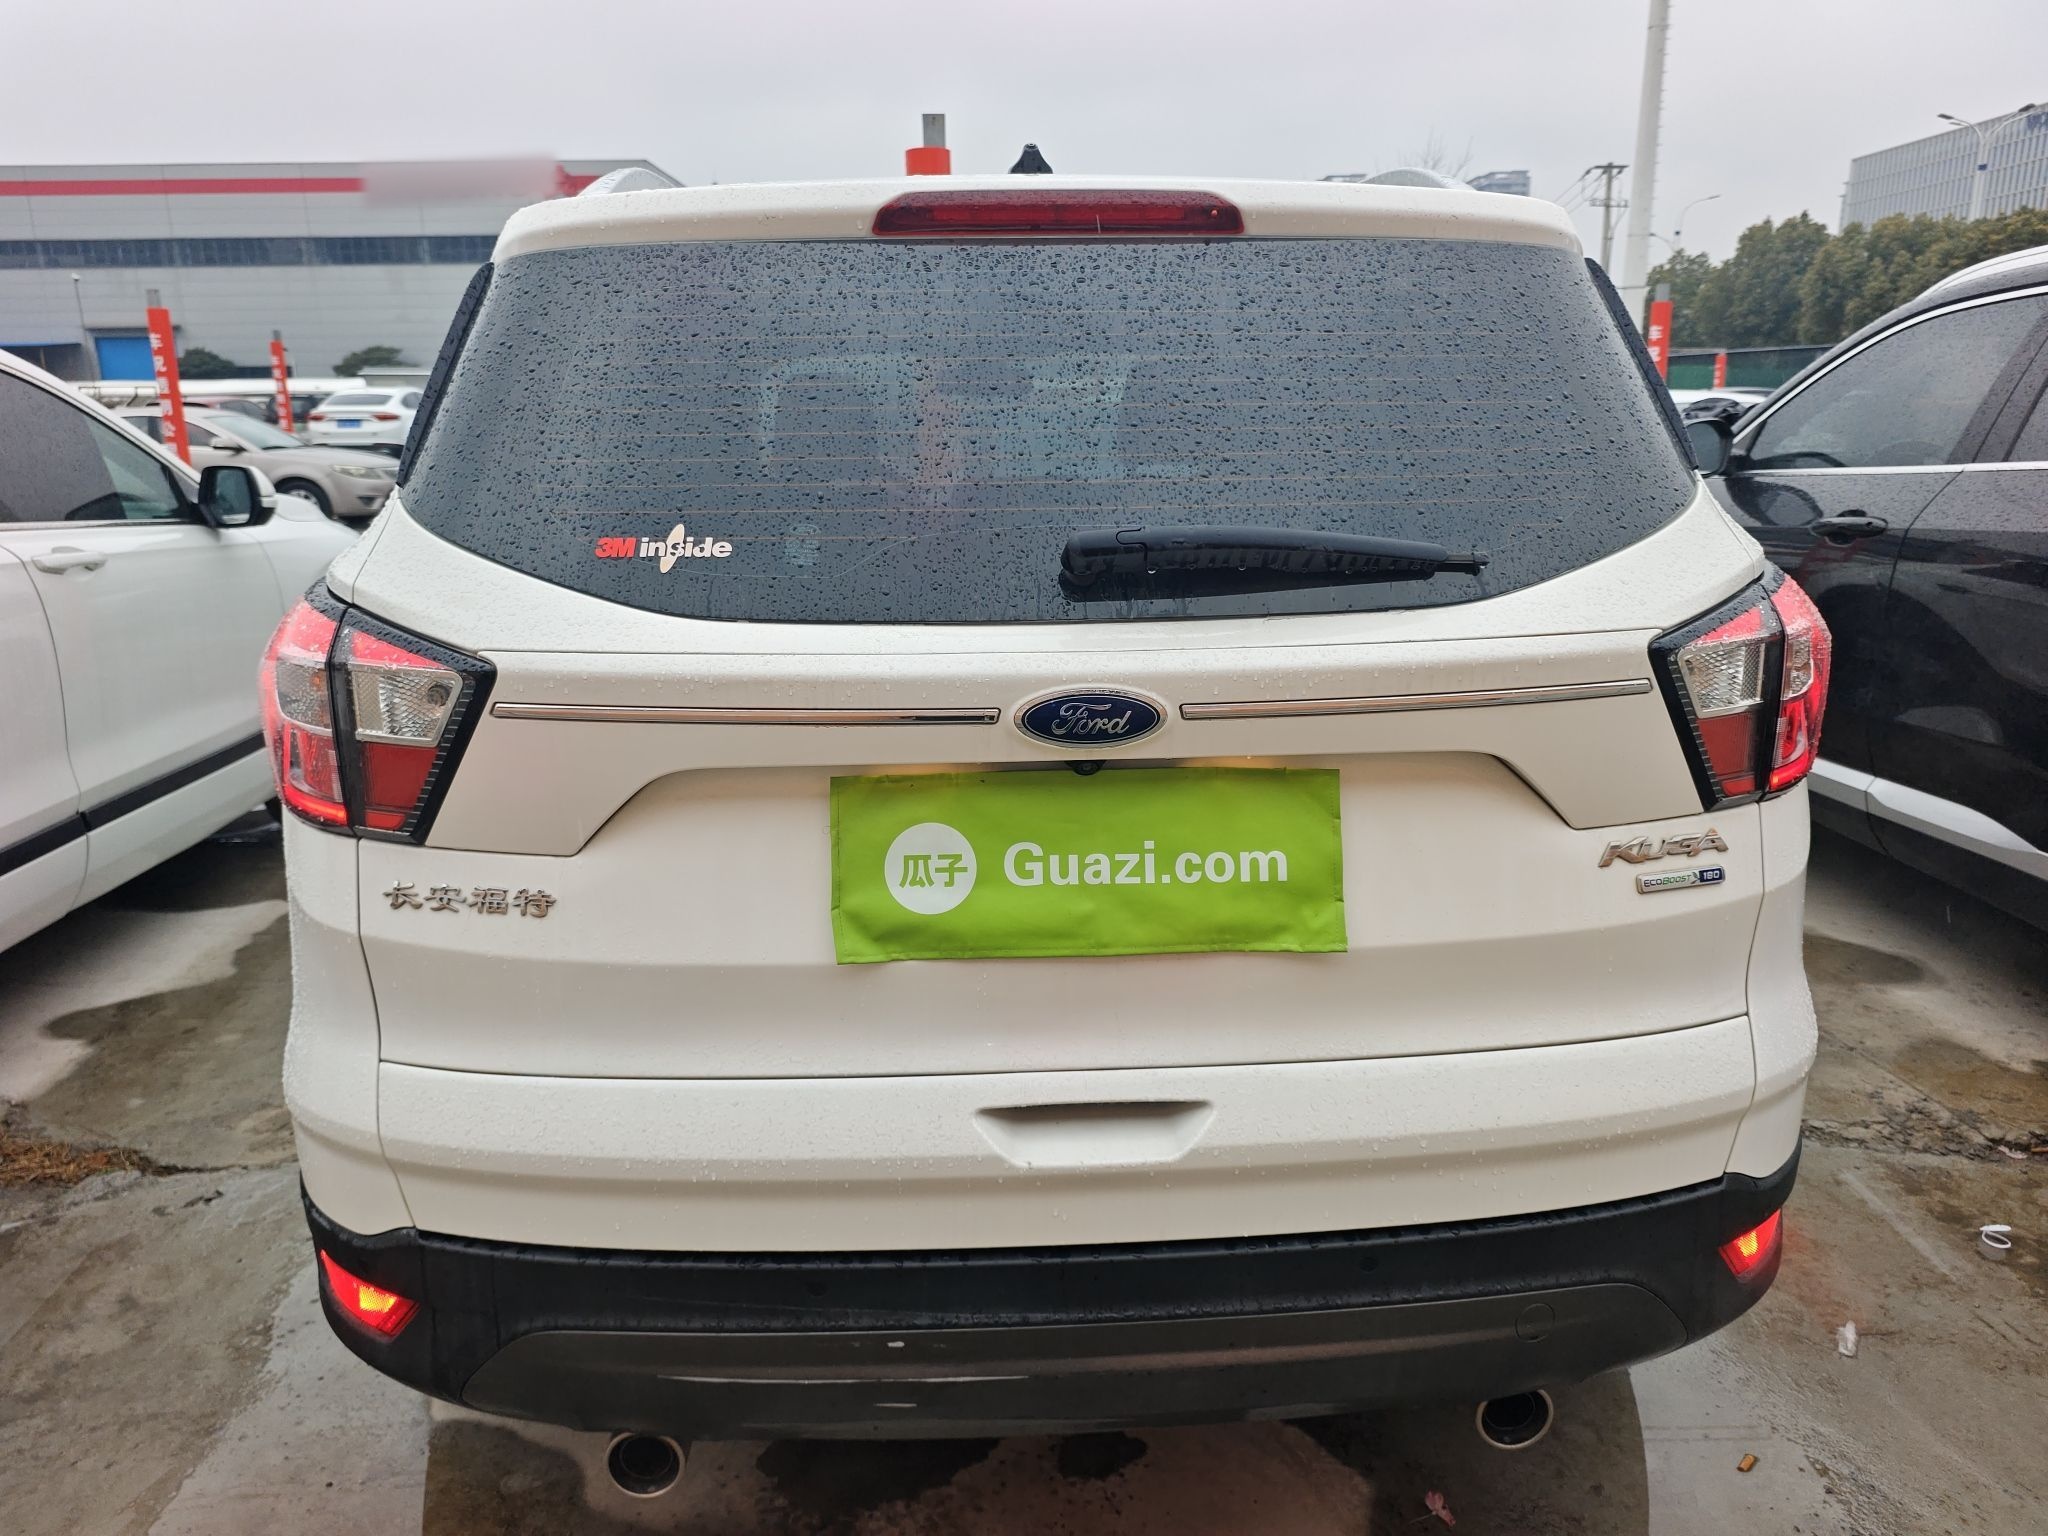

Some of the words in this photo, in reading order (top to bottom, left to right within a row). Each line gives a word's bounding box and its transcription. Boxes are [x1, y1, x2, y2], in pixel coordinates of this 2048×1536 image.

[595, 537, 637, 558] 3M
[639, 535, 733, 559] inside
[1051, 702, 1132, 735] Ford
[1003, 840, 1288, 887] Guazi.com
[1598, 828, 1729, 868] KUGA
[900, 853, 968, 889] 瓜子
[382, 880, 557, 918] 长安福特
